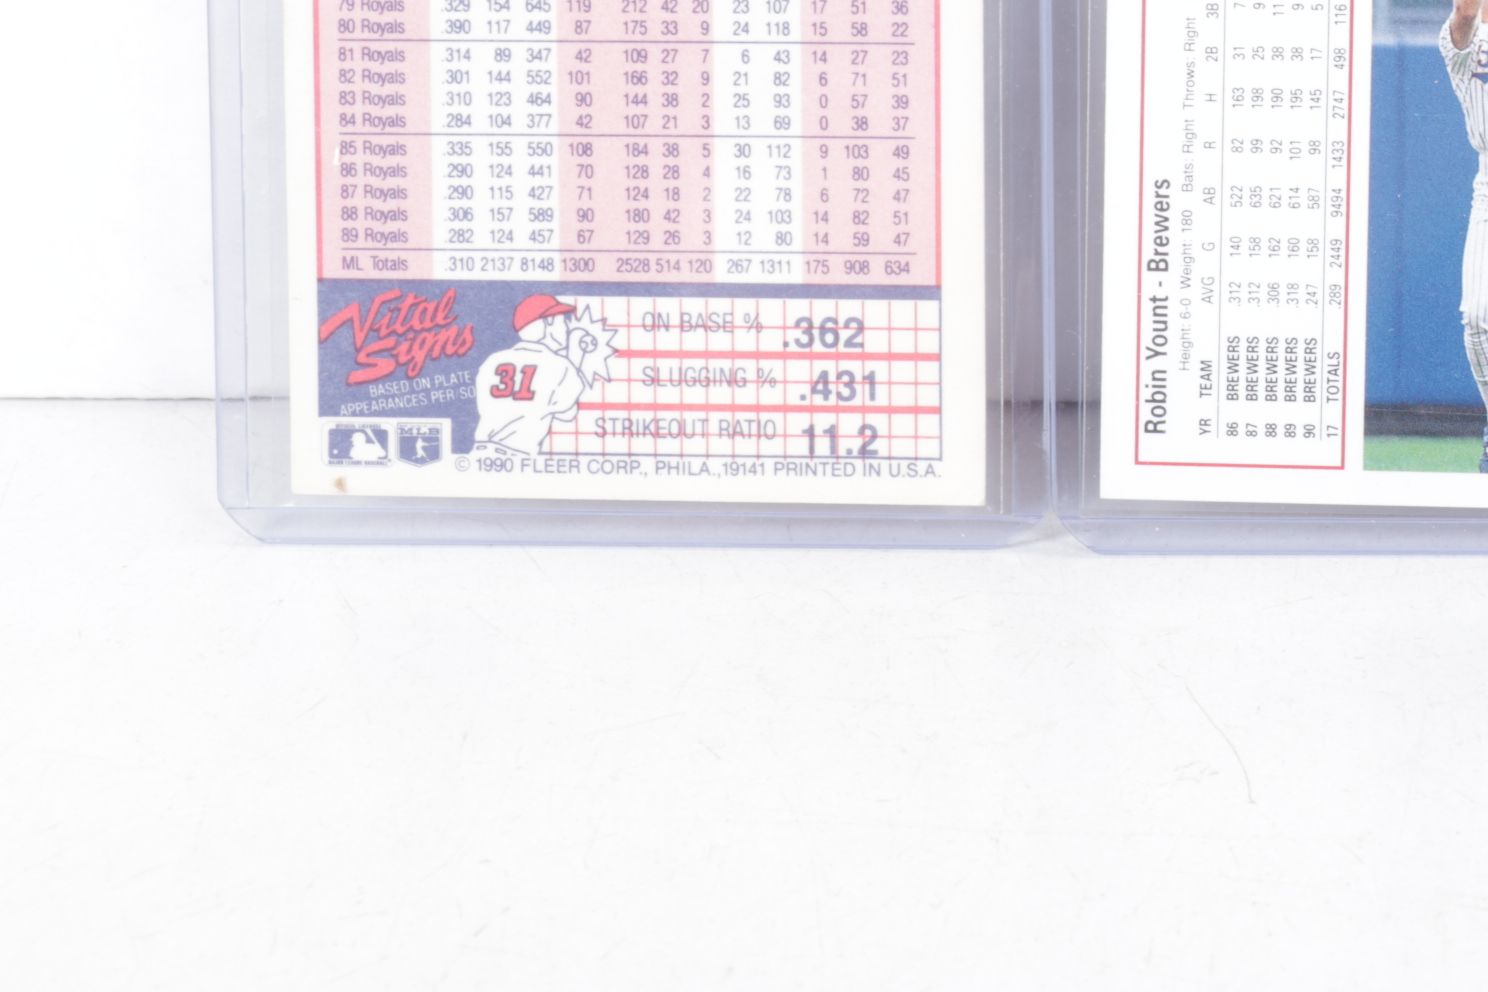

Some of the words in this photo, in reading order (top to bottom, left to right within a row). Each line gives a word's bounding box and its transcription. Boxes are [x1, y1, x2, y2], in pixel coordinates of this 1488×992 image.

[1184, 17, 1199, 52] Right
[1182, 57, 1197, 110] Throws:
[1182, 119, 1197, 154] Right
[1182, 159, 1194, 192] Bats:
[1147, 179, 1171, 272] Brewers
[1182, 210, 1193, 232] 180
[342, 256, 362, 270] ML
[370, 256, 408, 271] Totals
[445, 257, 474, 271] .310
[481, 257, 512, 271] 2137
[520, 257, 554, 271] 8148
[562, 258, 594, 272] 1300
[616, 258, 650, 273] 2528
[656, 259, 681, 273] 514
[688, 259, 712, 273] 120
[727, 260, 751, 274] 267
[760, 260, 791, 274] 1311
[805, 260, 830, 274] 175
[844, 260, 870, 275] 908
[885, 261, 910, 275] 634
[1180, 239, 1195, 289] Weight:
[319, 288, 457, 352] Vital
[1179, 298, 1191, 319] 6-0
[642, 312, 670, 332] ON
[682, 312, 734, 333] BASE
[744, 313, 763, 334] %
[783, 316, 864, 349] .362
[1146, 295, 1169, 360] Yount
[346, 323, 475, 385] Signs
[1178, 324, 1192, 371] Height:
[369, 379, 409, 397] BASED
[413, 378, 431, 390] ON
[435, 371, 471, 387] PLATE
[490, 363, 537, 401] 31
[642, 366, 747, 388] SLUGGING
[758, 368, 777, 388] %
[799, 370, 877, 402] .431
[1200, 360, 1213, 398] TEAM
[1327, 351, 1341, 404] TOTALS
[340, 394, 428, 416] APPEARANCES
[1144, 369, 1168, 434] Robin
[594, 417, 708, 439] STRIKEOUT
[719, 419, 777, 440] RATIO
[802, 424, 878, 456] 11.2
[1199, 419, 1212, 436] YR
[1327, 424, 1339, 438] 17
[476, 458, 514, 472] 1990
[520, 459, 580, 473] FLEER
[774, 462, 855, 477] PRINTED
[863, 463, 881, 477] IN
[889, 464, 941, 478] U.S.A.
